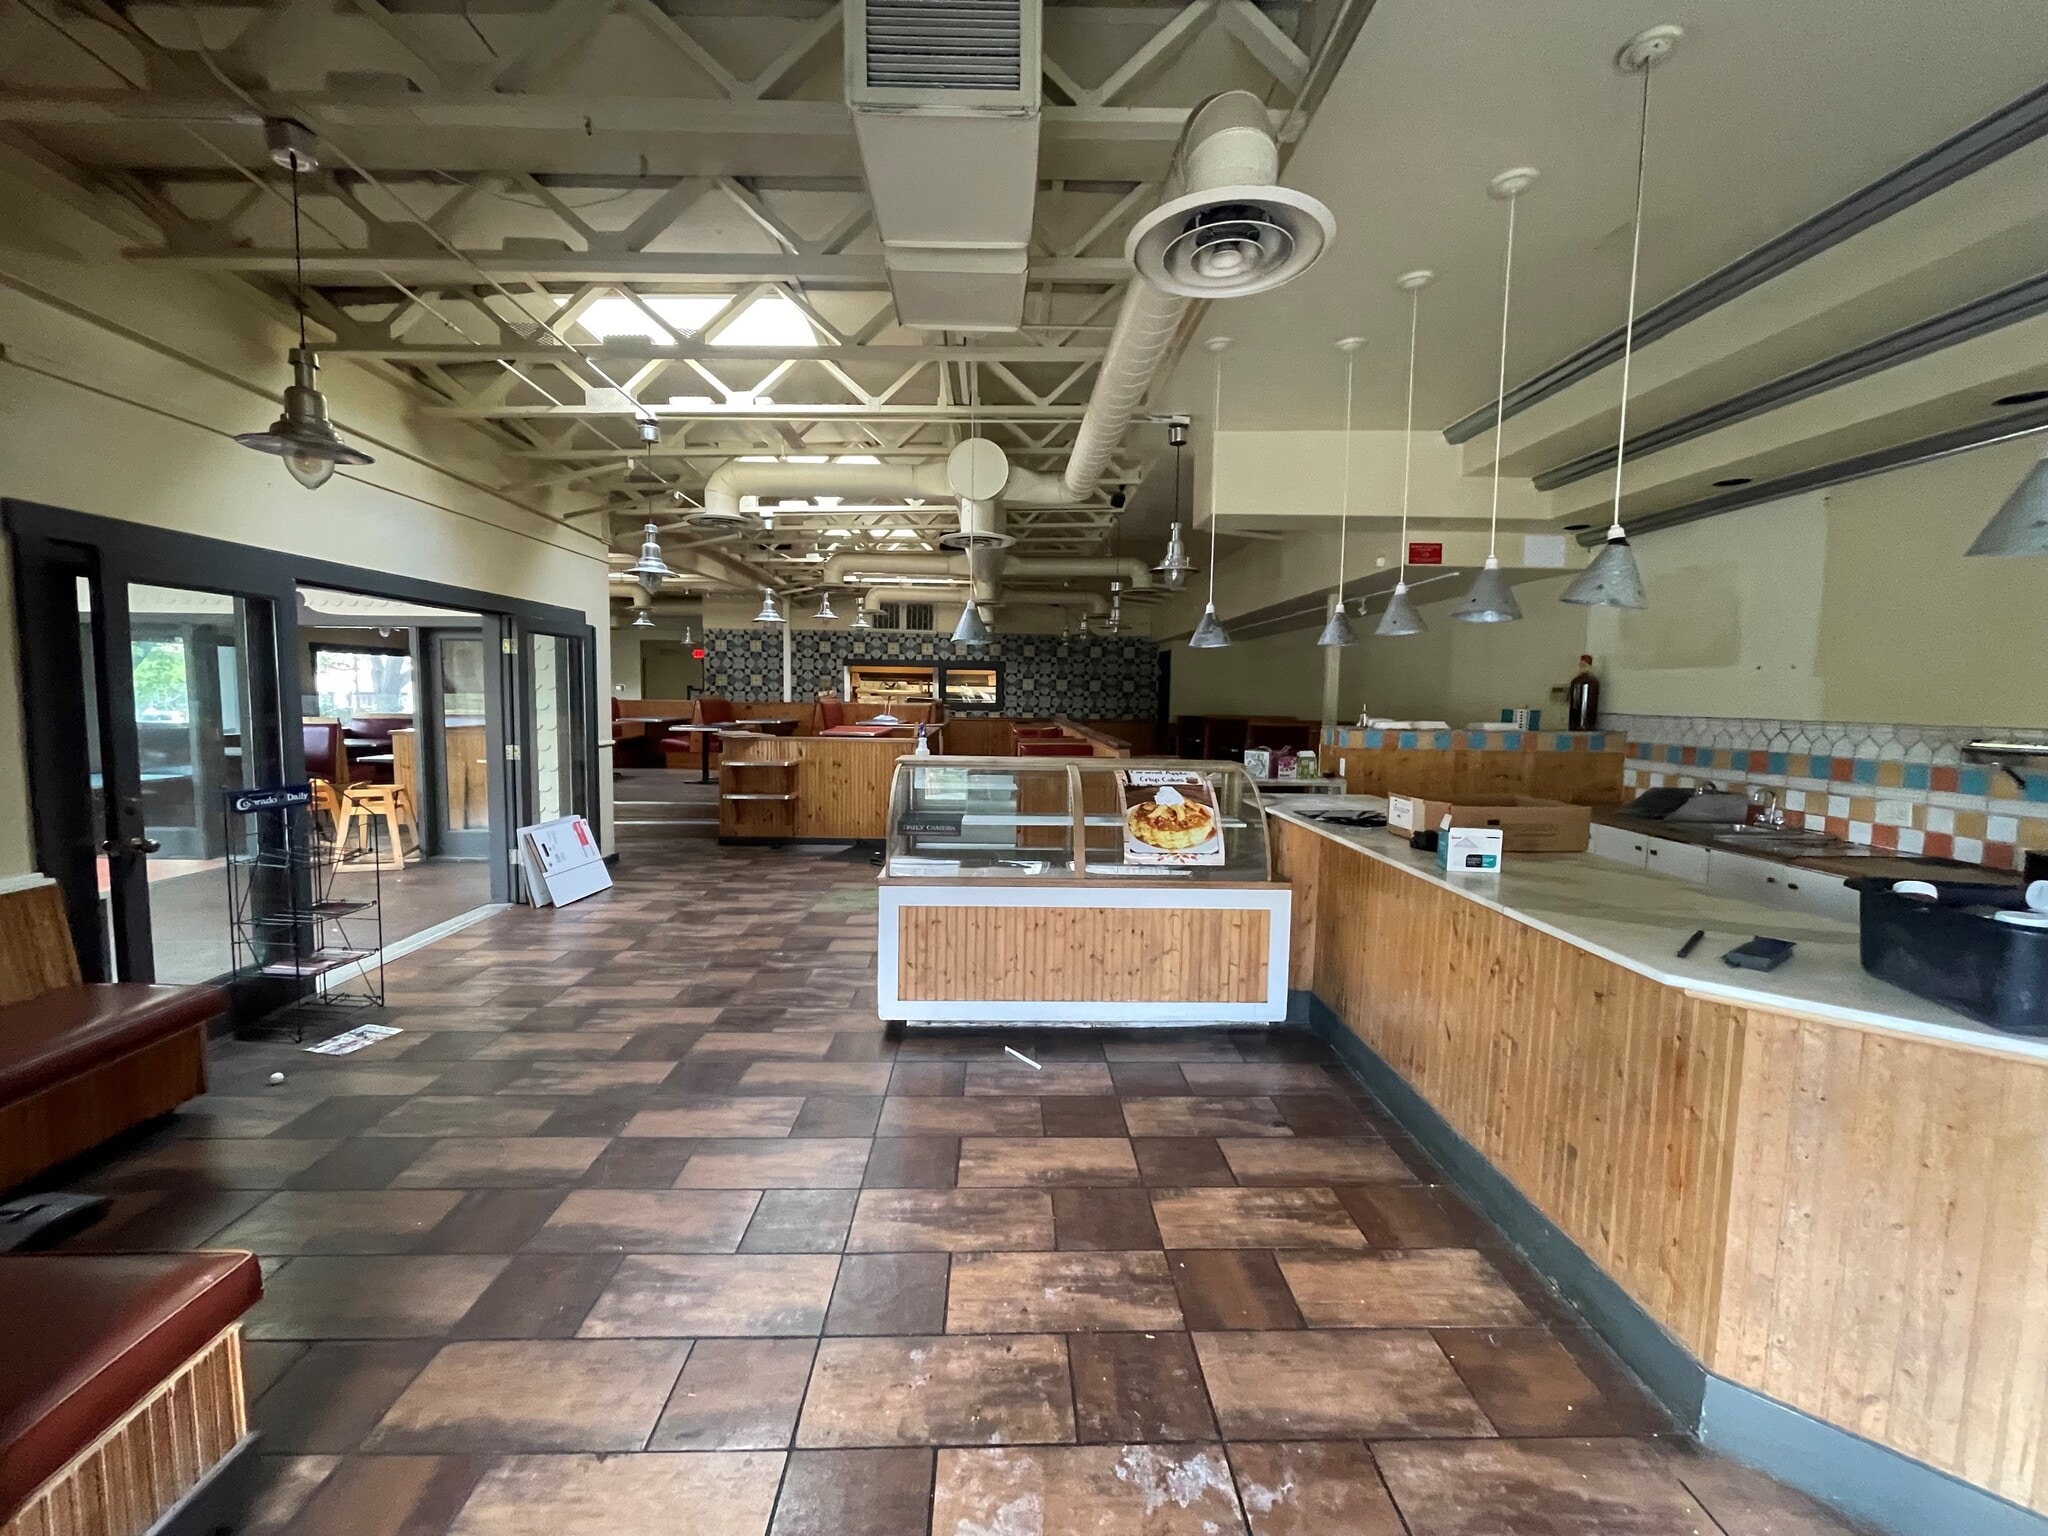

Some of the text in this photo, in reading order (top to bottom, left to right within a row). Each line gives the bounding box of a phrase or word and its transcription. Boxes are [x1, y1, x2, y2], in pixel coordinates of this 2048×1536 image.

[236, 792, 309, 811] Corado Daily
[926, 824, 956, 832] CAMERA
